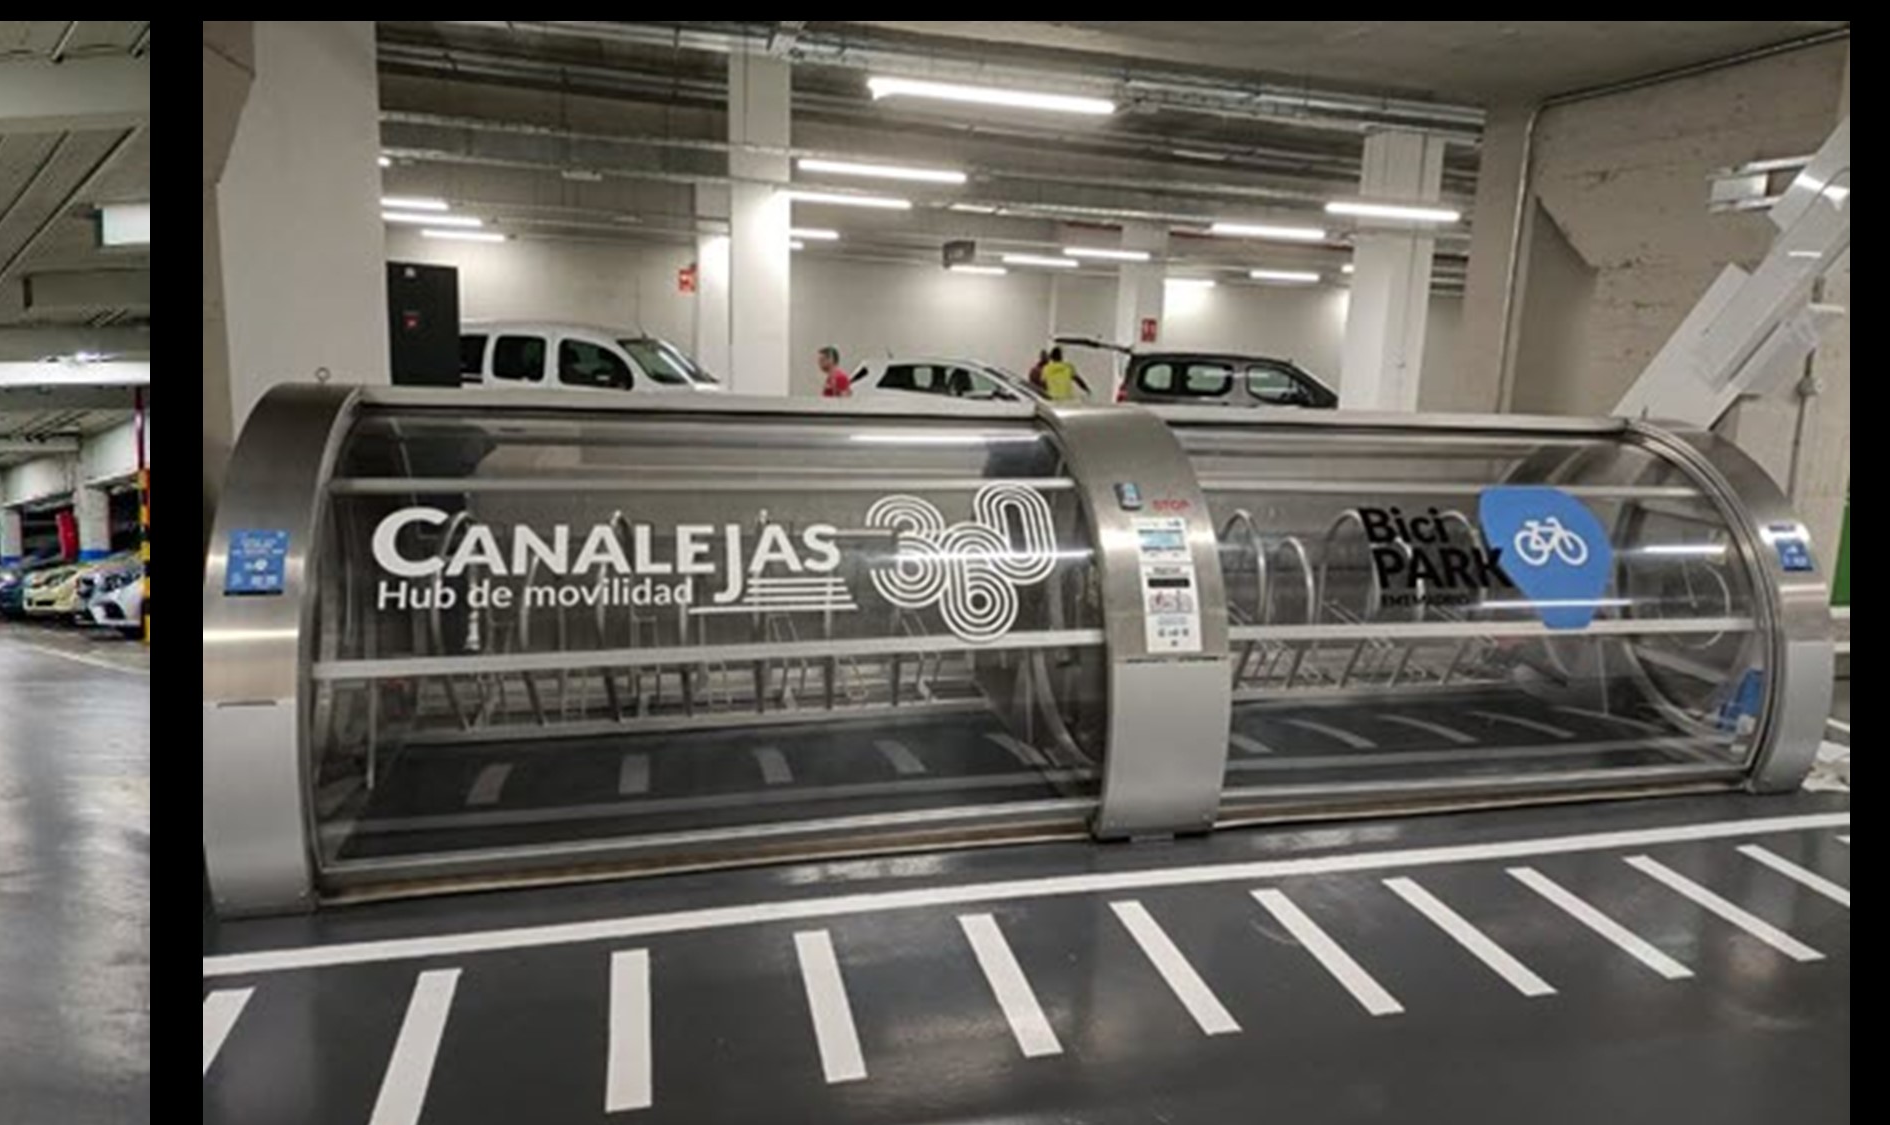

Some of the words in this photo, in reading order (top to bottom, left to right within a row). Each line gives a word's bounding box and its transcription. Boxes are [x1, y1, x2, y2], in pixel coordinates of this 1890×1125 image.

[1358, 506, 1450, 543] Bici
[372, 507, 842, 602] CANALEJAS
[865, 479, 1057, 644] 360
[1373, 547, 1515, 588] PARK
[377, 579, 448, 610] Hub
[467, 575, 512, 608] de
[523, 575, 693, 607] movilidad
